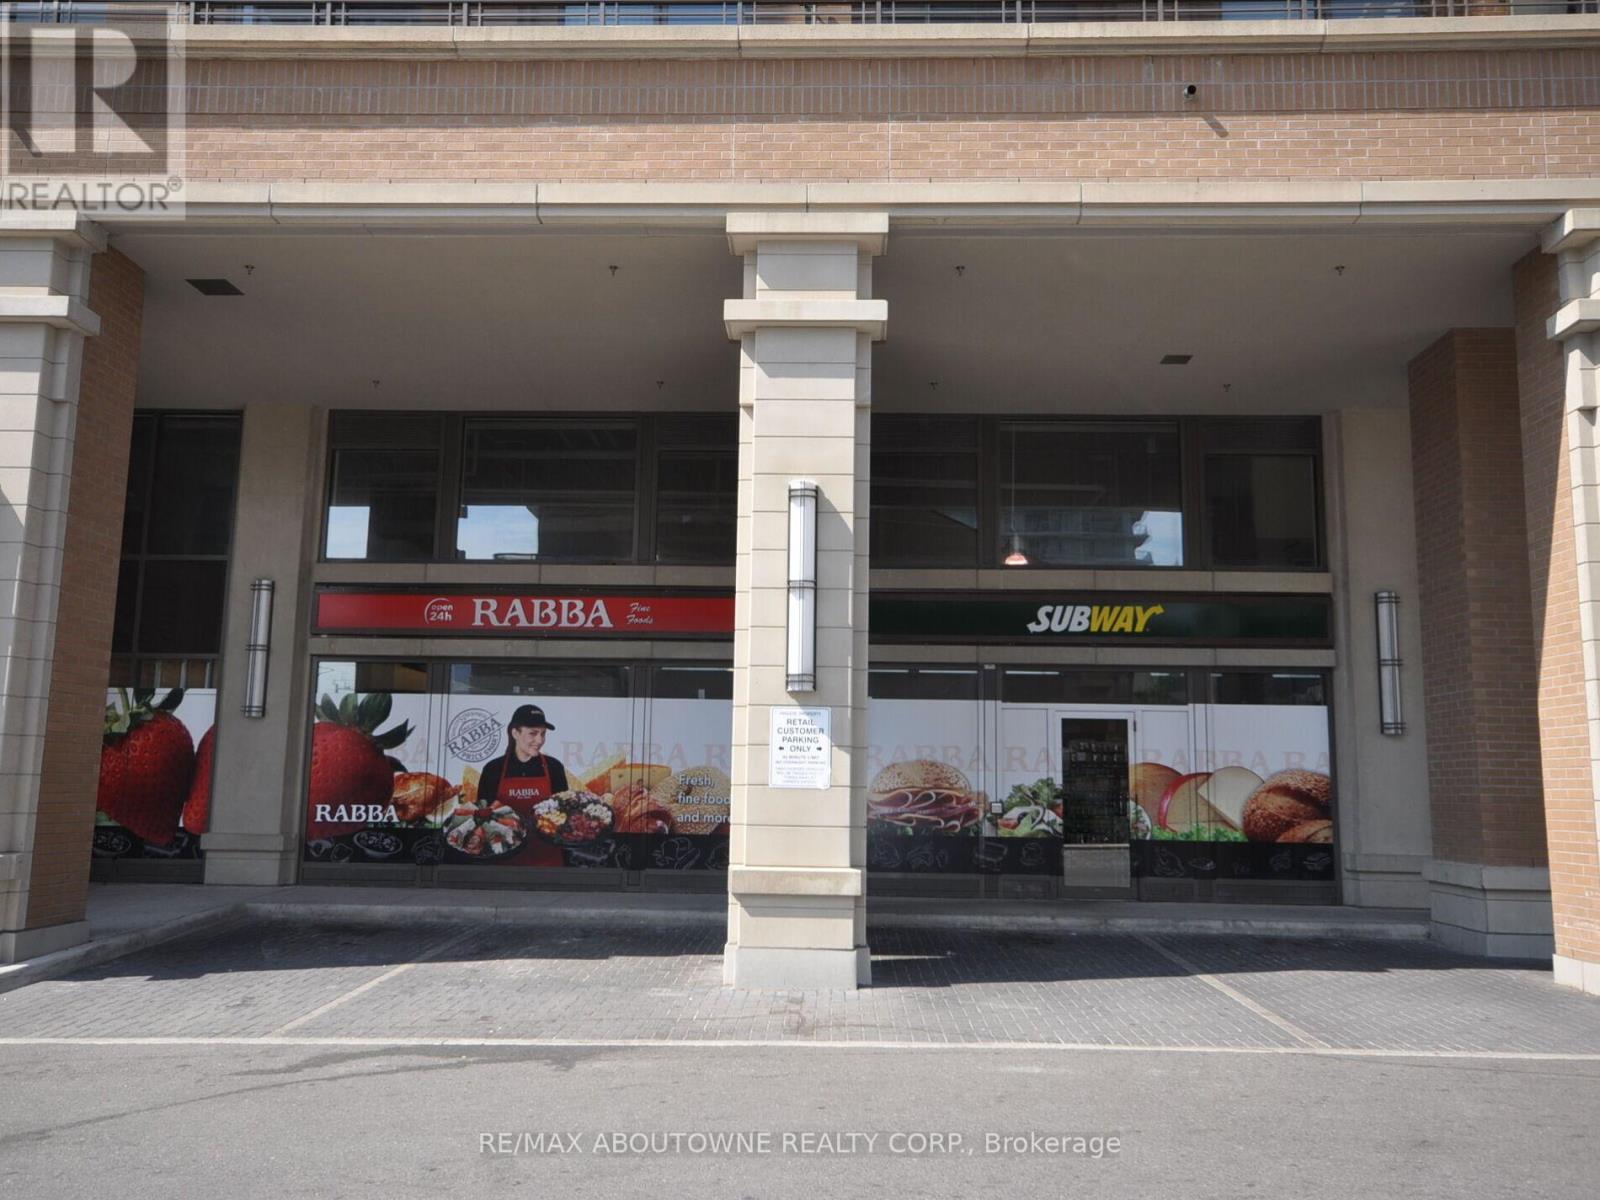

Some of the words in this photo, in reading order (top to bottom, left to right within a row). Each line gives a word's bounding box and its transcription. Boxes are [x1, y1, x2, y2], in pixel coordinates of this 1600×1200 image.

[430, 611, 452, 621] 24h
[472, 598, 614, 628] RABBA
[1026, 604, 1164, 632] SUBWAY
[448, 718, 502, 755] RABBA
[777, 727, 824, 735] CUSTOMER
[782, 736, 819, 744] PARKING
[789, 745, 811, 753] ONLY
[680, 774, 715, 787] Fresh,
[509, 788, 540, 796] RABBA
[678, 792, 700, 804] fine
[314, 804, 400, 823] RABBA
[677, 810, 700, 823] and
[704, 815, 731, 824] mor
